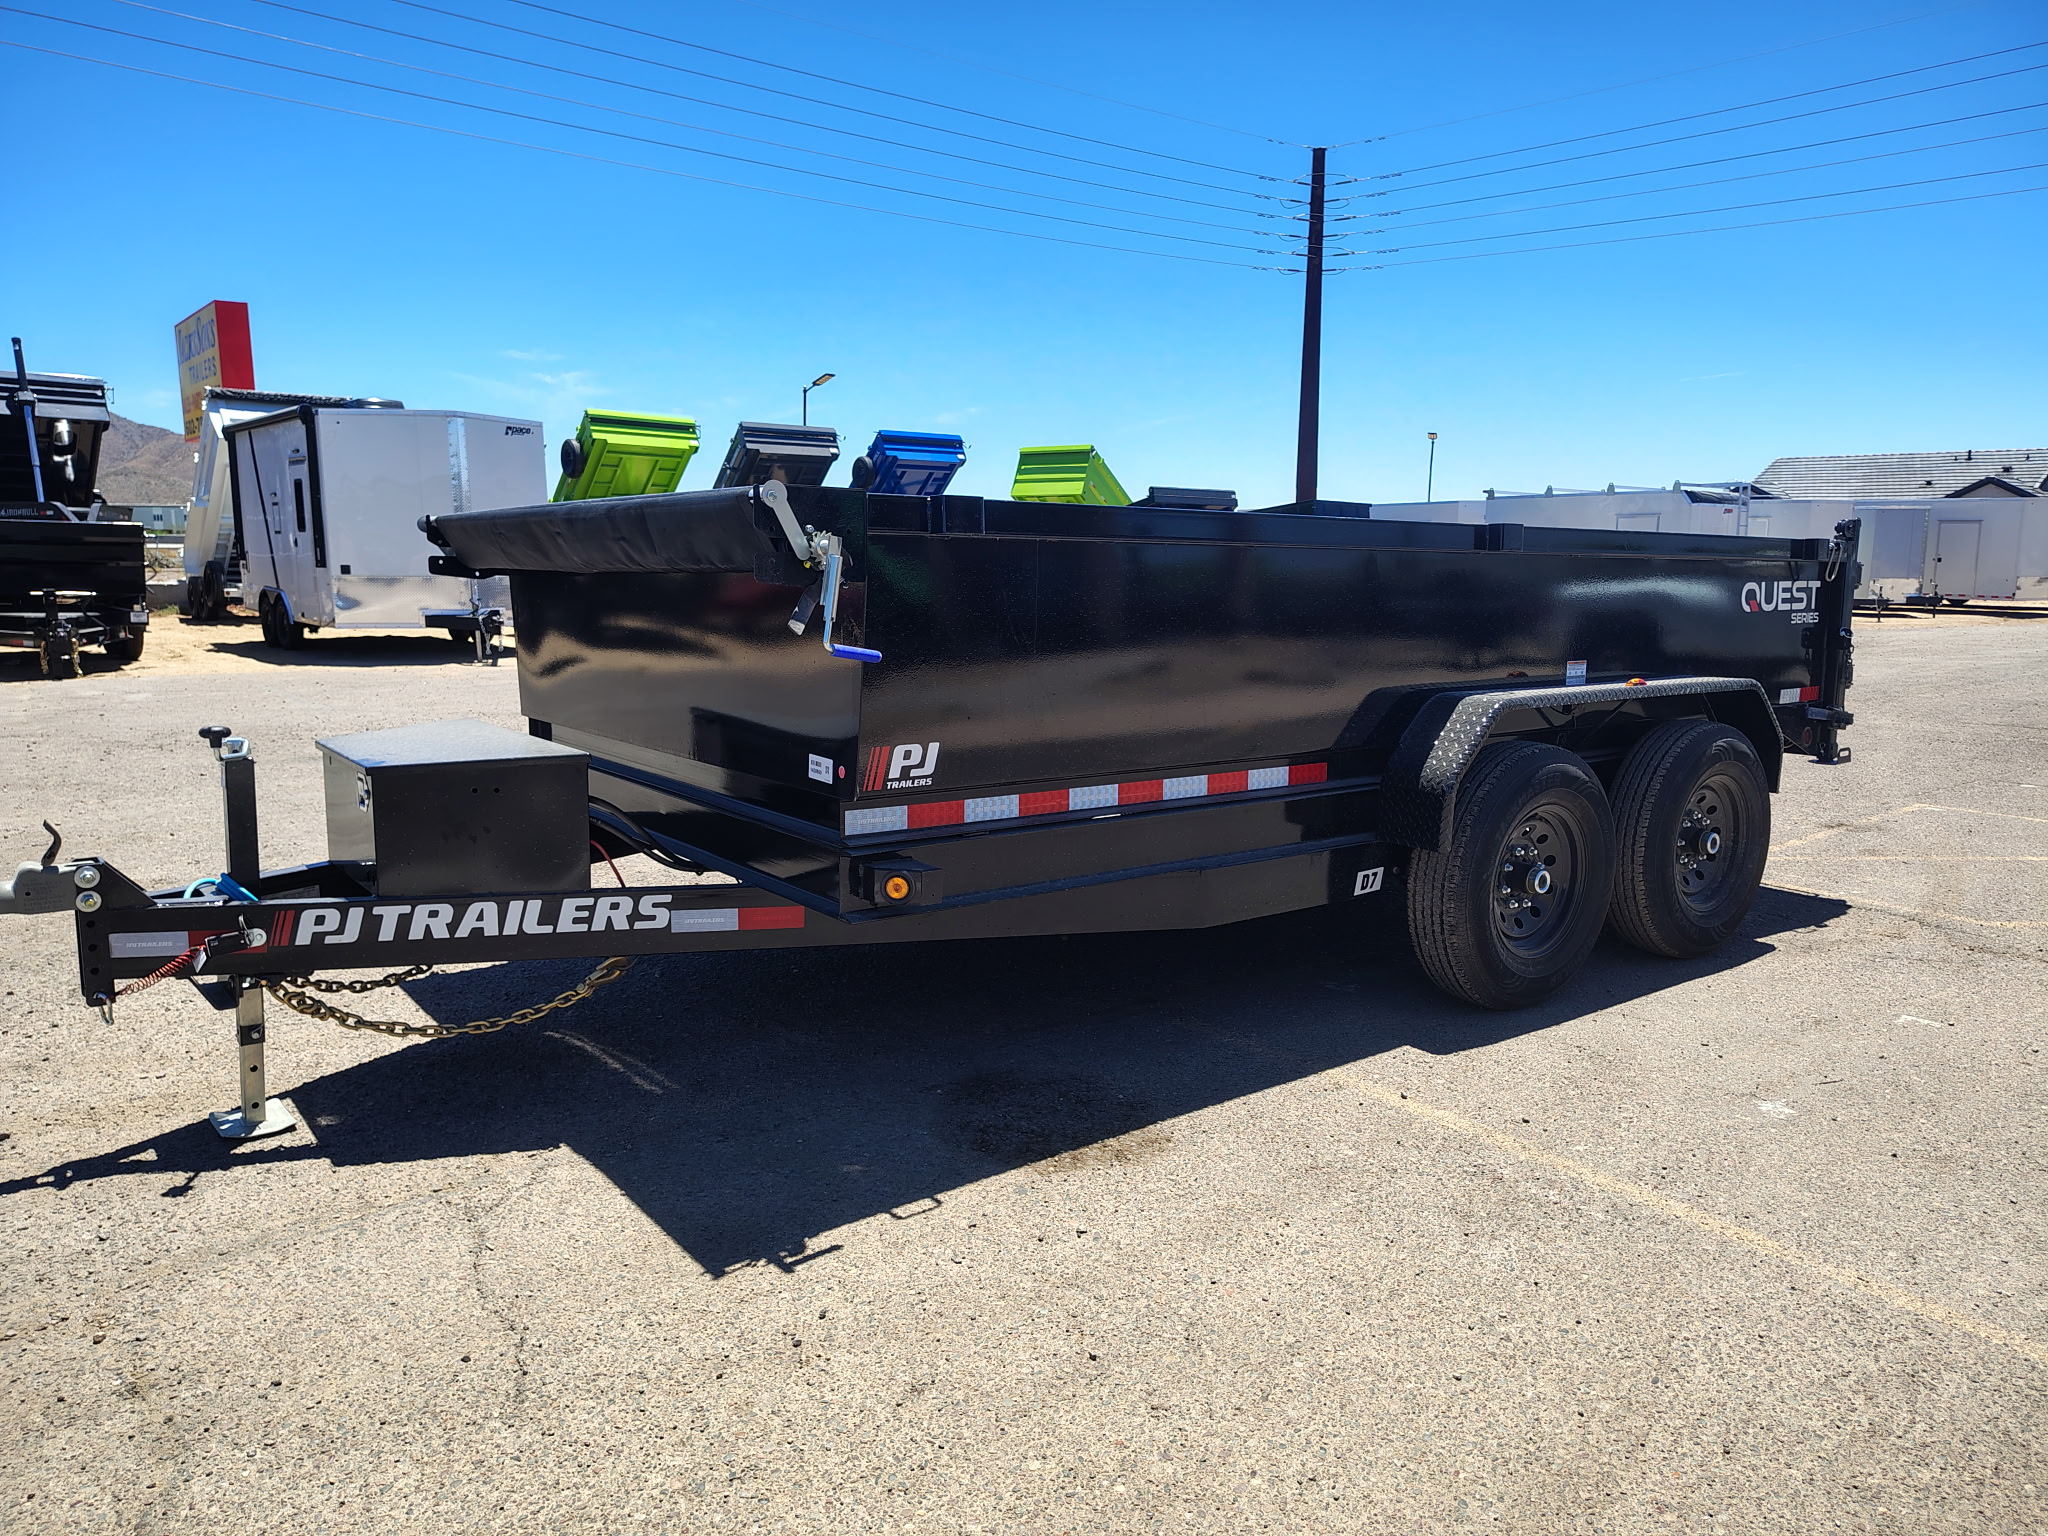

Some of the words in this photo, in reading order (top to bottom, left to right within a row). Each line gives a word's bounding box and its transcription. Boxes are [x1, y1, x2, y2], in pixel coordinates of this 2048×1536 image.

[188, 356, 217, 385] TRAILERS
[1741, 580, 1821, 612] QUEST
[1790, 612, 1819, 624] SERIES
[888, 741, 940, 779] PJ
[886, 777, 933, 790] TRAILERS
[372, 895, 672, 942] TRAILERS
